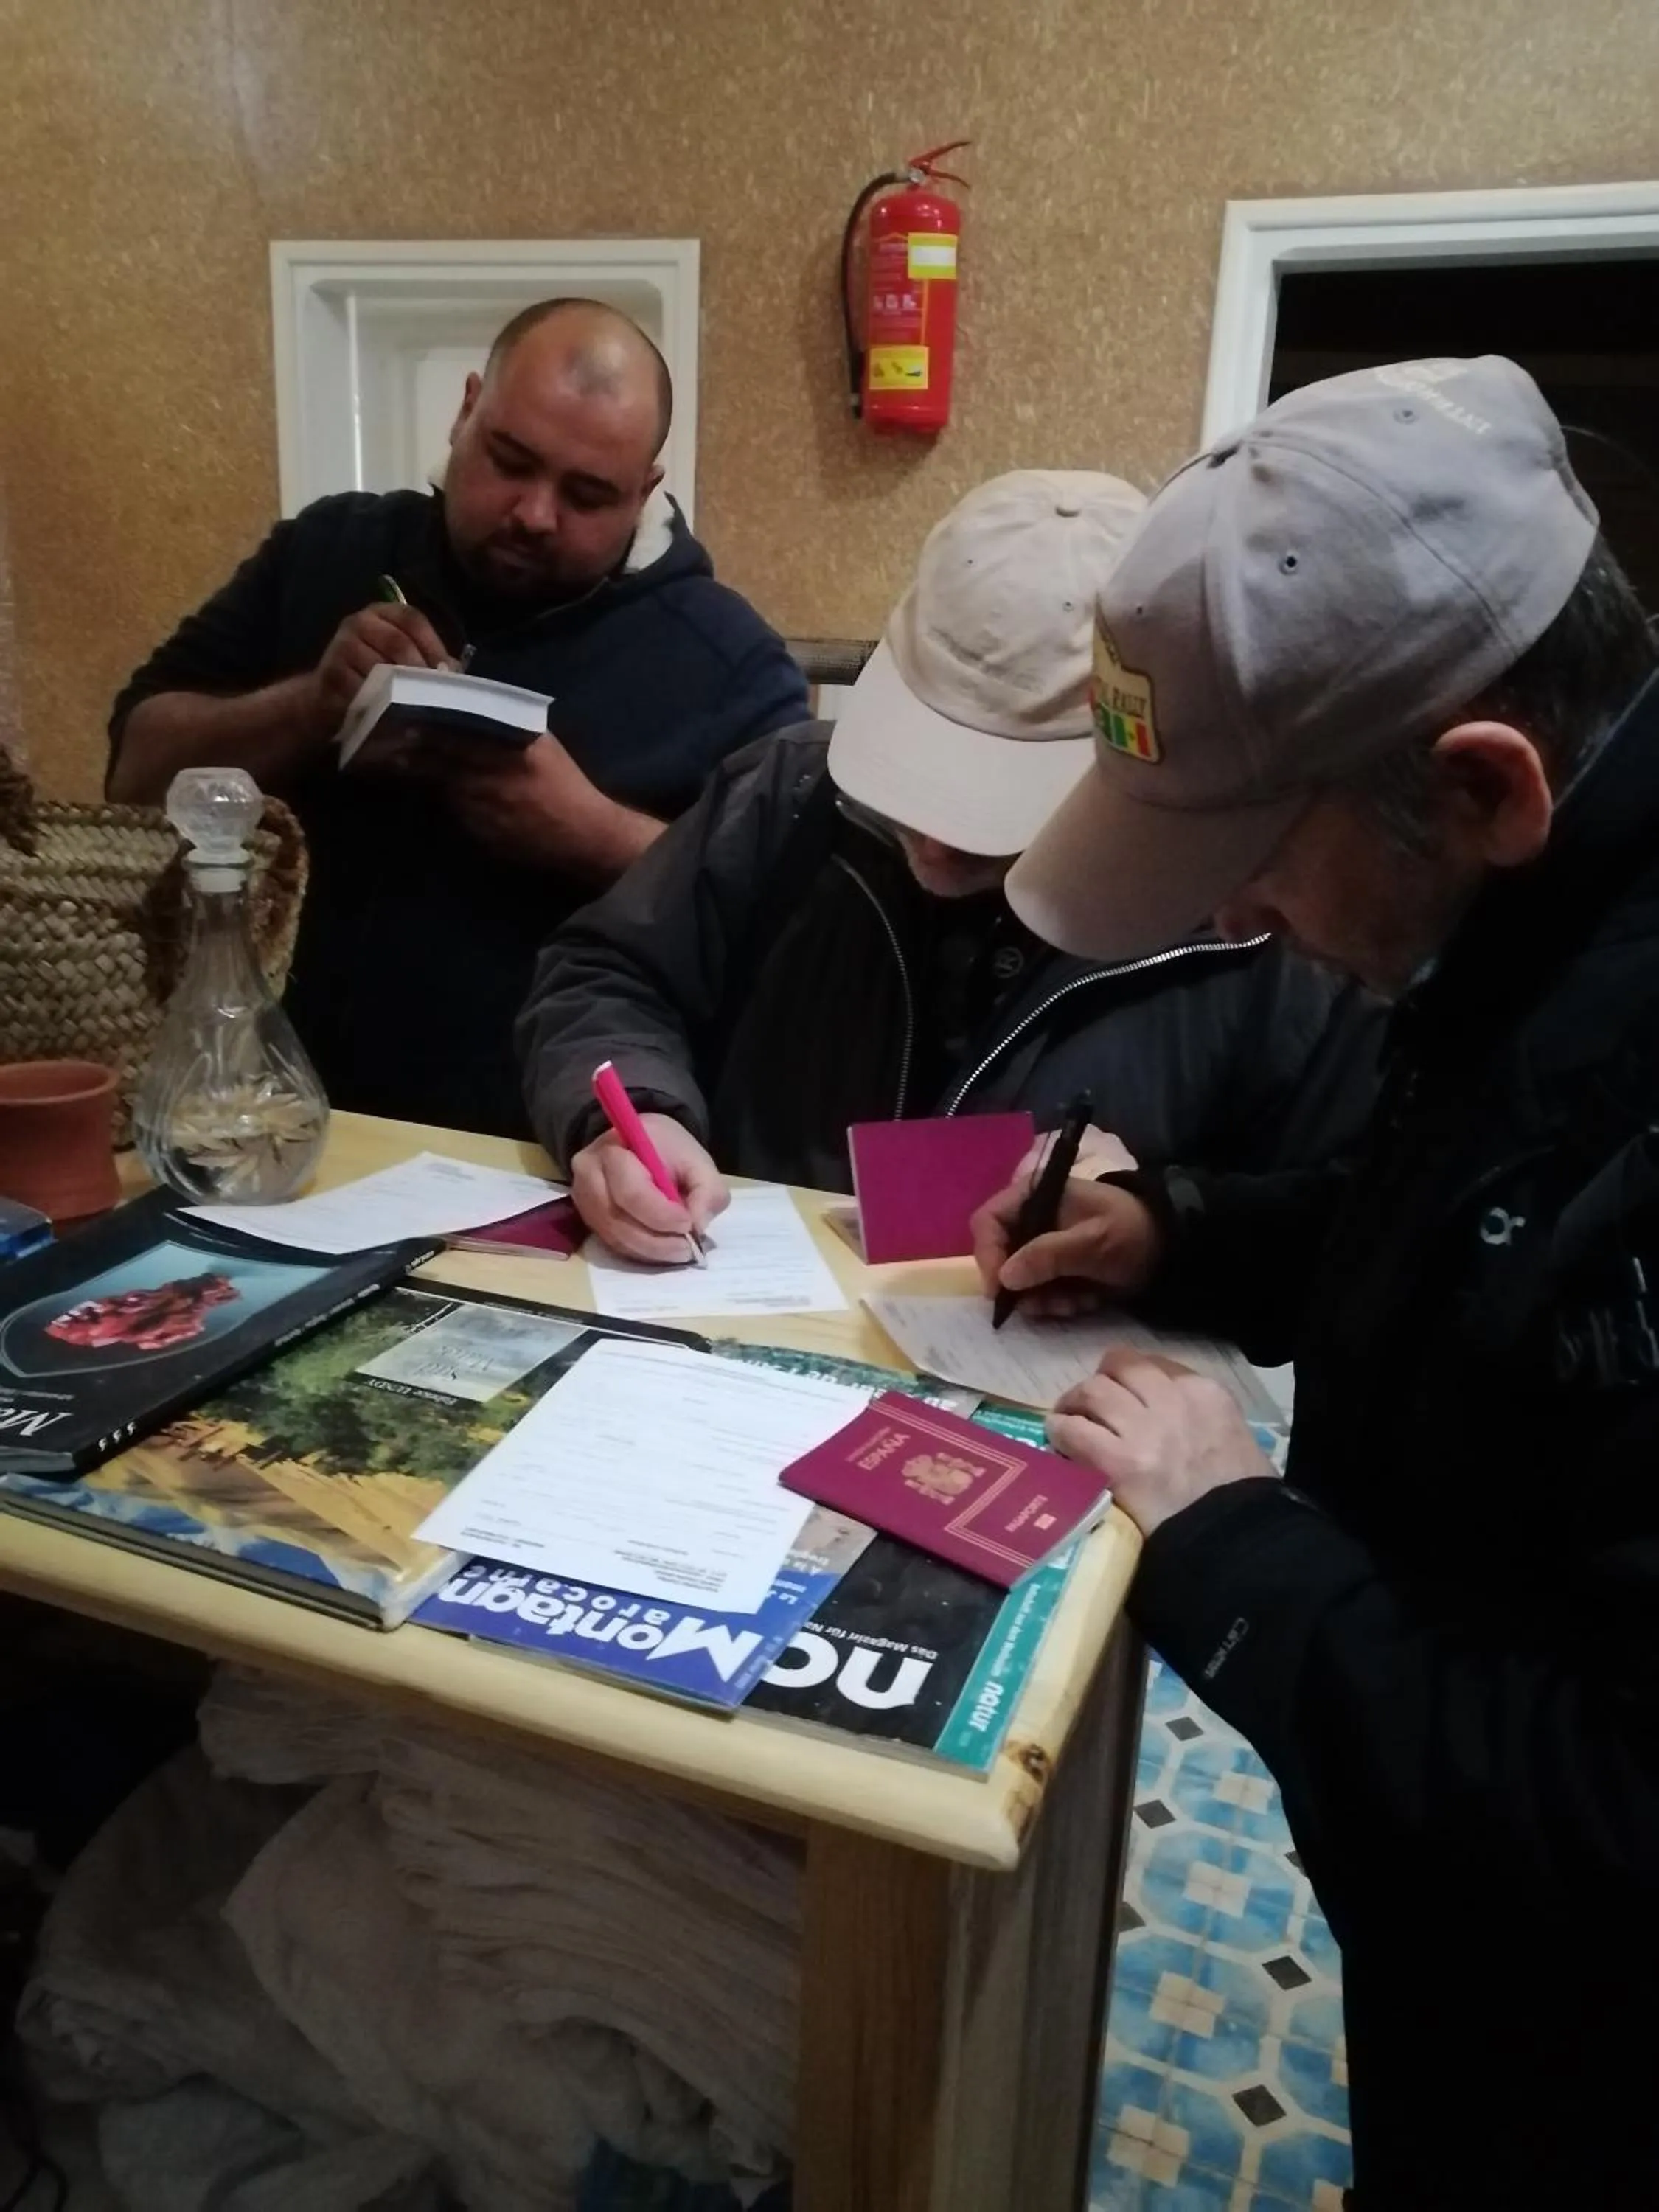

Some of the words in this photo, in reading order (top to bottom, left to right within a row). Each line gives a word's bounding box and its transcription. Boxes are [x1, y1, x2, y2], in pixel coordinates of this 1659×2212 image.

[858, 1433, 911, 1471] ESPAÑA
[437, 1576, 764, 1683] Montagn
[824, 1623, 846, 1639] für
[846, 1630, 908, 1653] Magazin
[911, 1643, 939, 1660] Das
[969, 1682, 1004, 1732] natur
